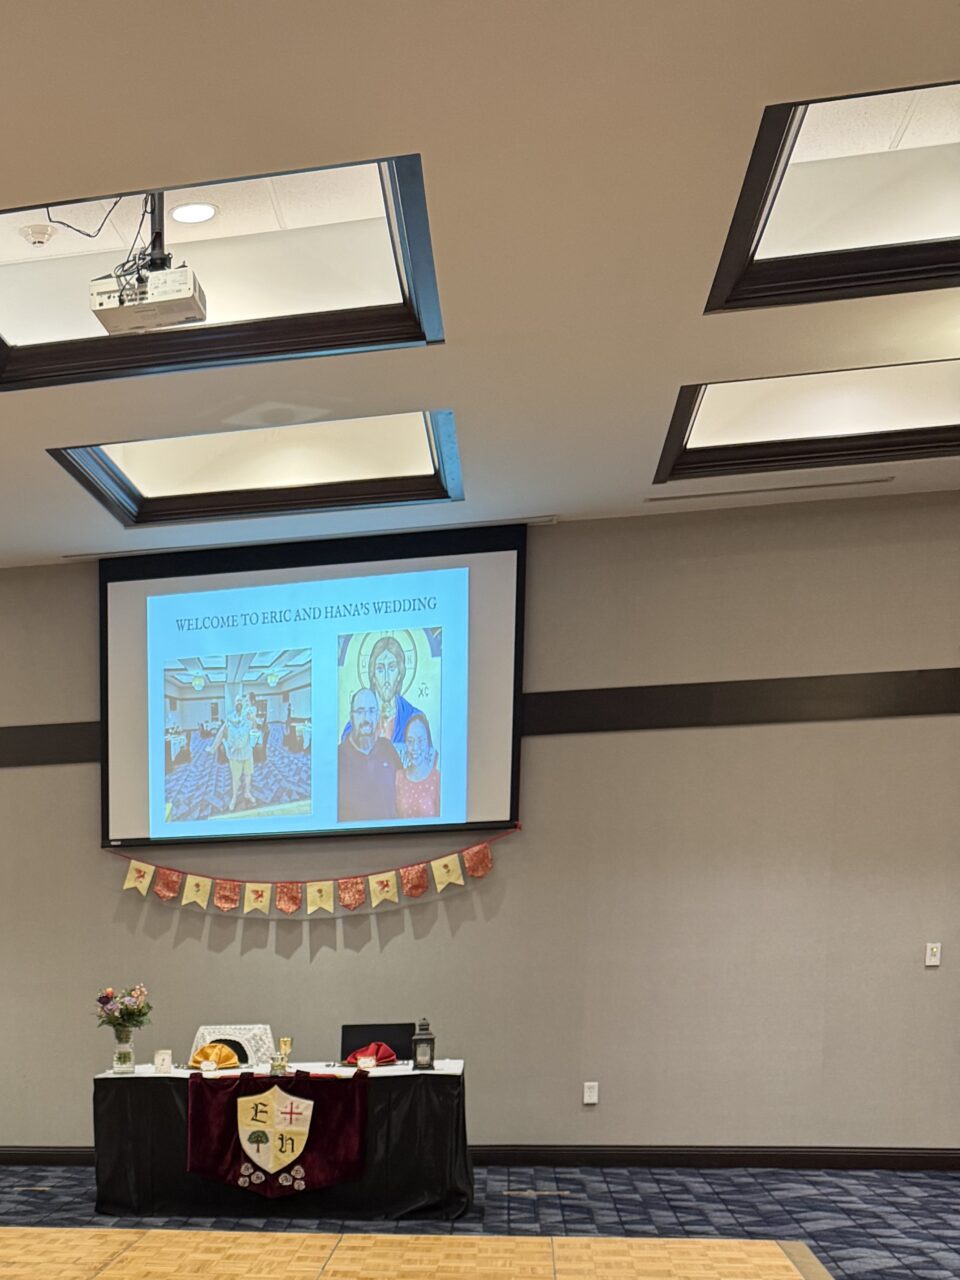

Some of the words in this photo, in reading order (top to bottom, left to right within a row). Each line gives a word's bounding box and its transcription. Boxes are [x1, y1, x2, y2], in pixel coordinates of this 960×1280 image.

[176, 614, 239, 632] WELCOME
[240, 612, 259, 626] TO
[261, 608, 291, 625] ERIC
[294, 606, 321, 622] AND
[324, 602, 370, 620] HANA'S
[372, 596, 437, 615] WEDDING
[251, 1102, 268, 1124] E
